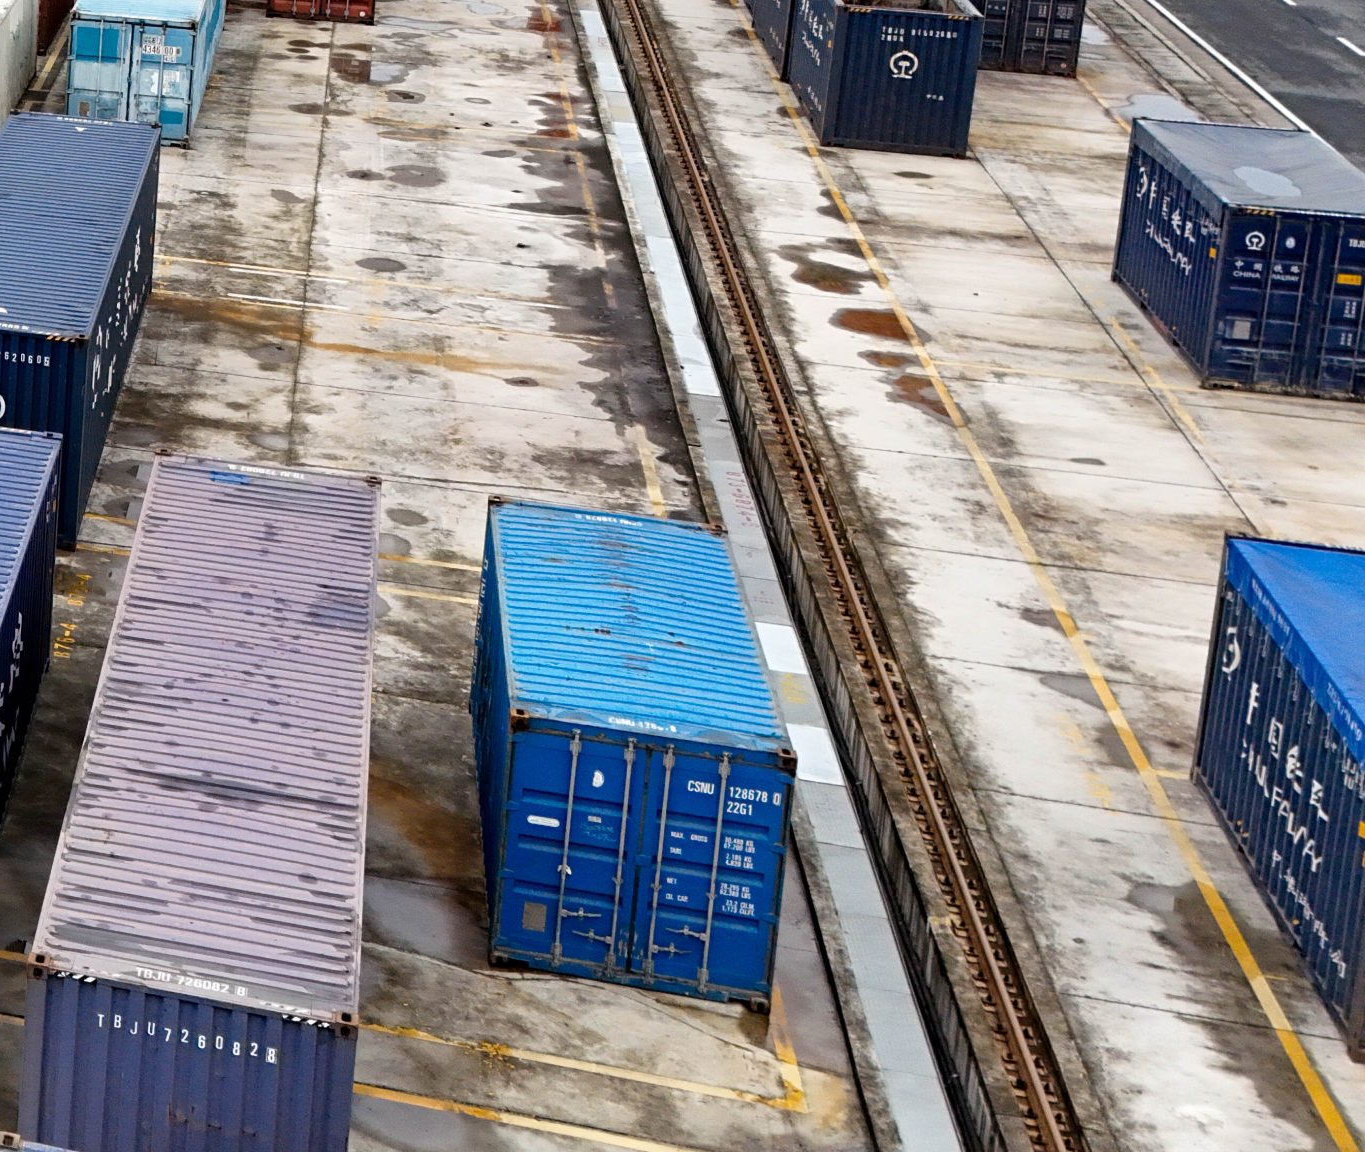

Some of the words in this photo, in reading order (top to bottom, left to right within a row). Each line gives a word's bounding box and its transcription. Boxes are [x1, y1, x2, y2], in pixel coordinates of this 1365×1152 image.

[1233, 270, 1261, 279] CHINA
[687, 779, 715, 795] CSNU
[729, 786, 769, 803] 128678
[772, 792, 781, 806] 0
[726, 800, 754, 816] 22G1
[135, 966, 171, 983] TBJU
[177, 974, 230, 994] 726082
